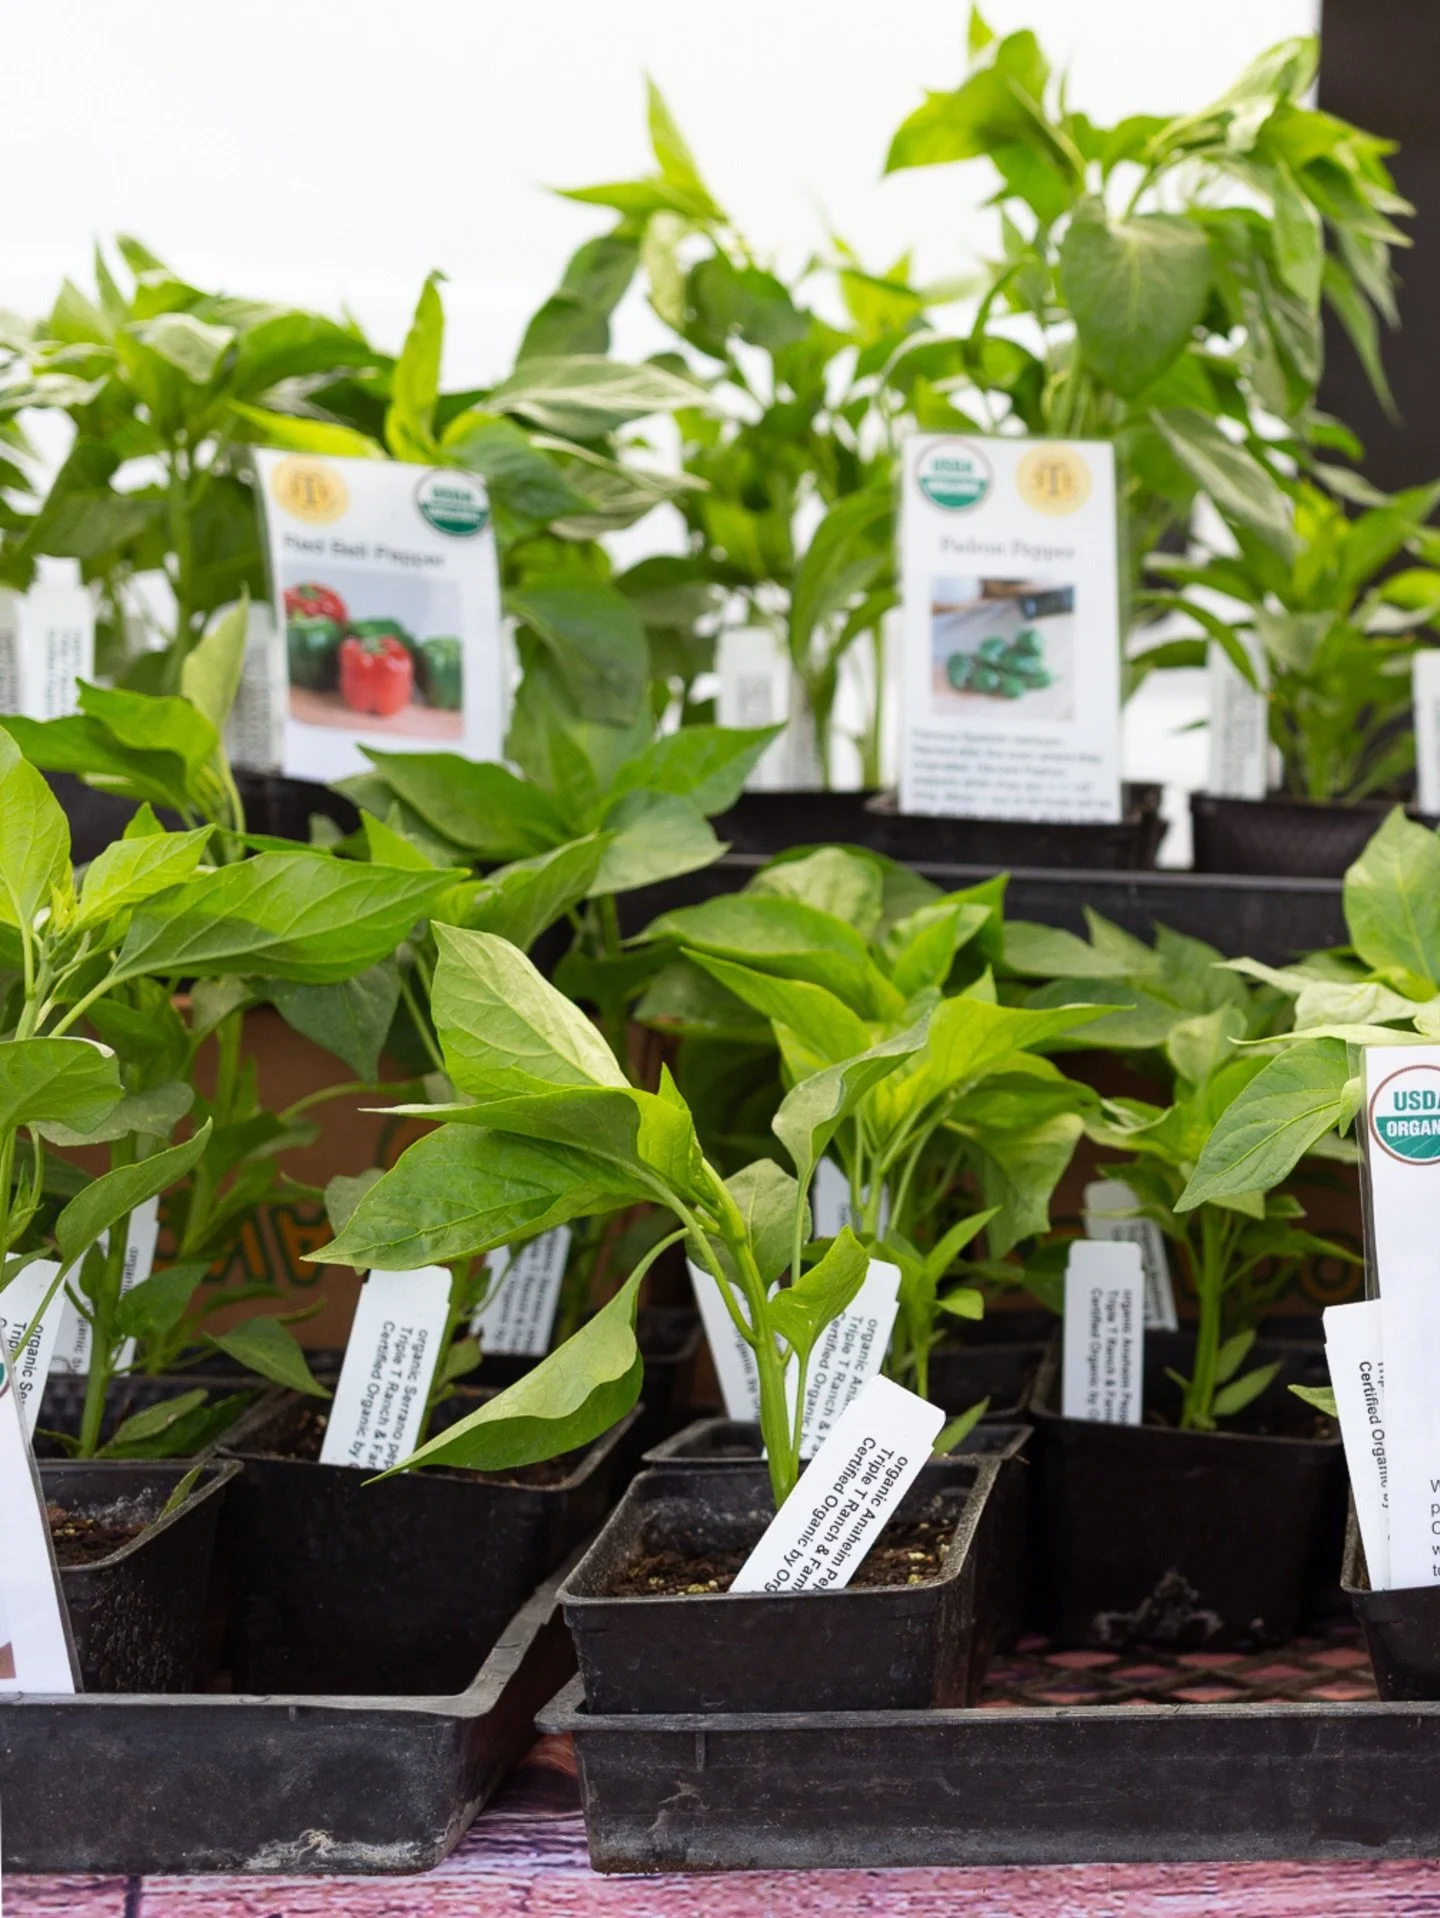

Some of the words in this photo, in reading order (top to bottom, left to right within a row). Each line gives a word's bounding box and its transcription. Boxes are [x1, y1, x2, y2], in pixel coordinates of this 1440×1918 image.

[1393, 1090, 1440, 1111] USD
[371, 1321, 396, 1380] Certified
[392, 1327, 413, 1365] Triple
[407, 1329, 428, 1381] organic
[841, 1316, 864, 1355] Triple
[854, 1318, 878, 1371] organic
[391, 1371, 403, 1379] T
[838, 1360, 851, 1369] T
[356, 1383, 380, 1437] Organic
[378, 1381, 399, 1426] Ranch
[392, 1386, 417, 1440] Serrano
[823, 1371, 846, 1417] Ranch
[1359, 1361, 1382, 1425] Certified
[374, 1429, 387, 1439] &
[818, 1420, 831, 1430] &
[348, 1440, 365, 1458] by
[833, 1437, 876, 1495] Certified
[861, 1448, 895, 1485] Triple
[854, 1489, 868, 1501] T
[870, 1456, 908, 1507] organic
[797, 1495, 839, 1547] Organic
[824, 1499, 860, 1542] Ranch
[831, 1508, 876, 1567] Anaheim
[783, 1548, 804, 1568] by
[815, 1544, 830, 1556] &
